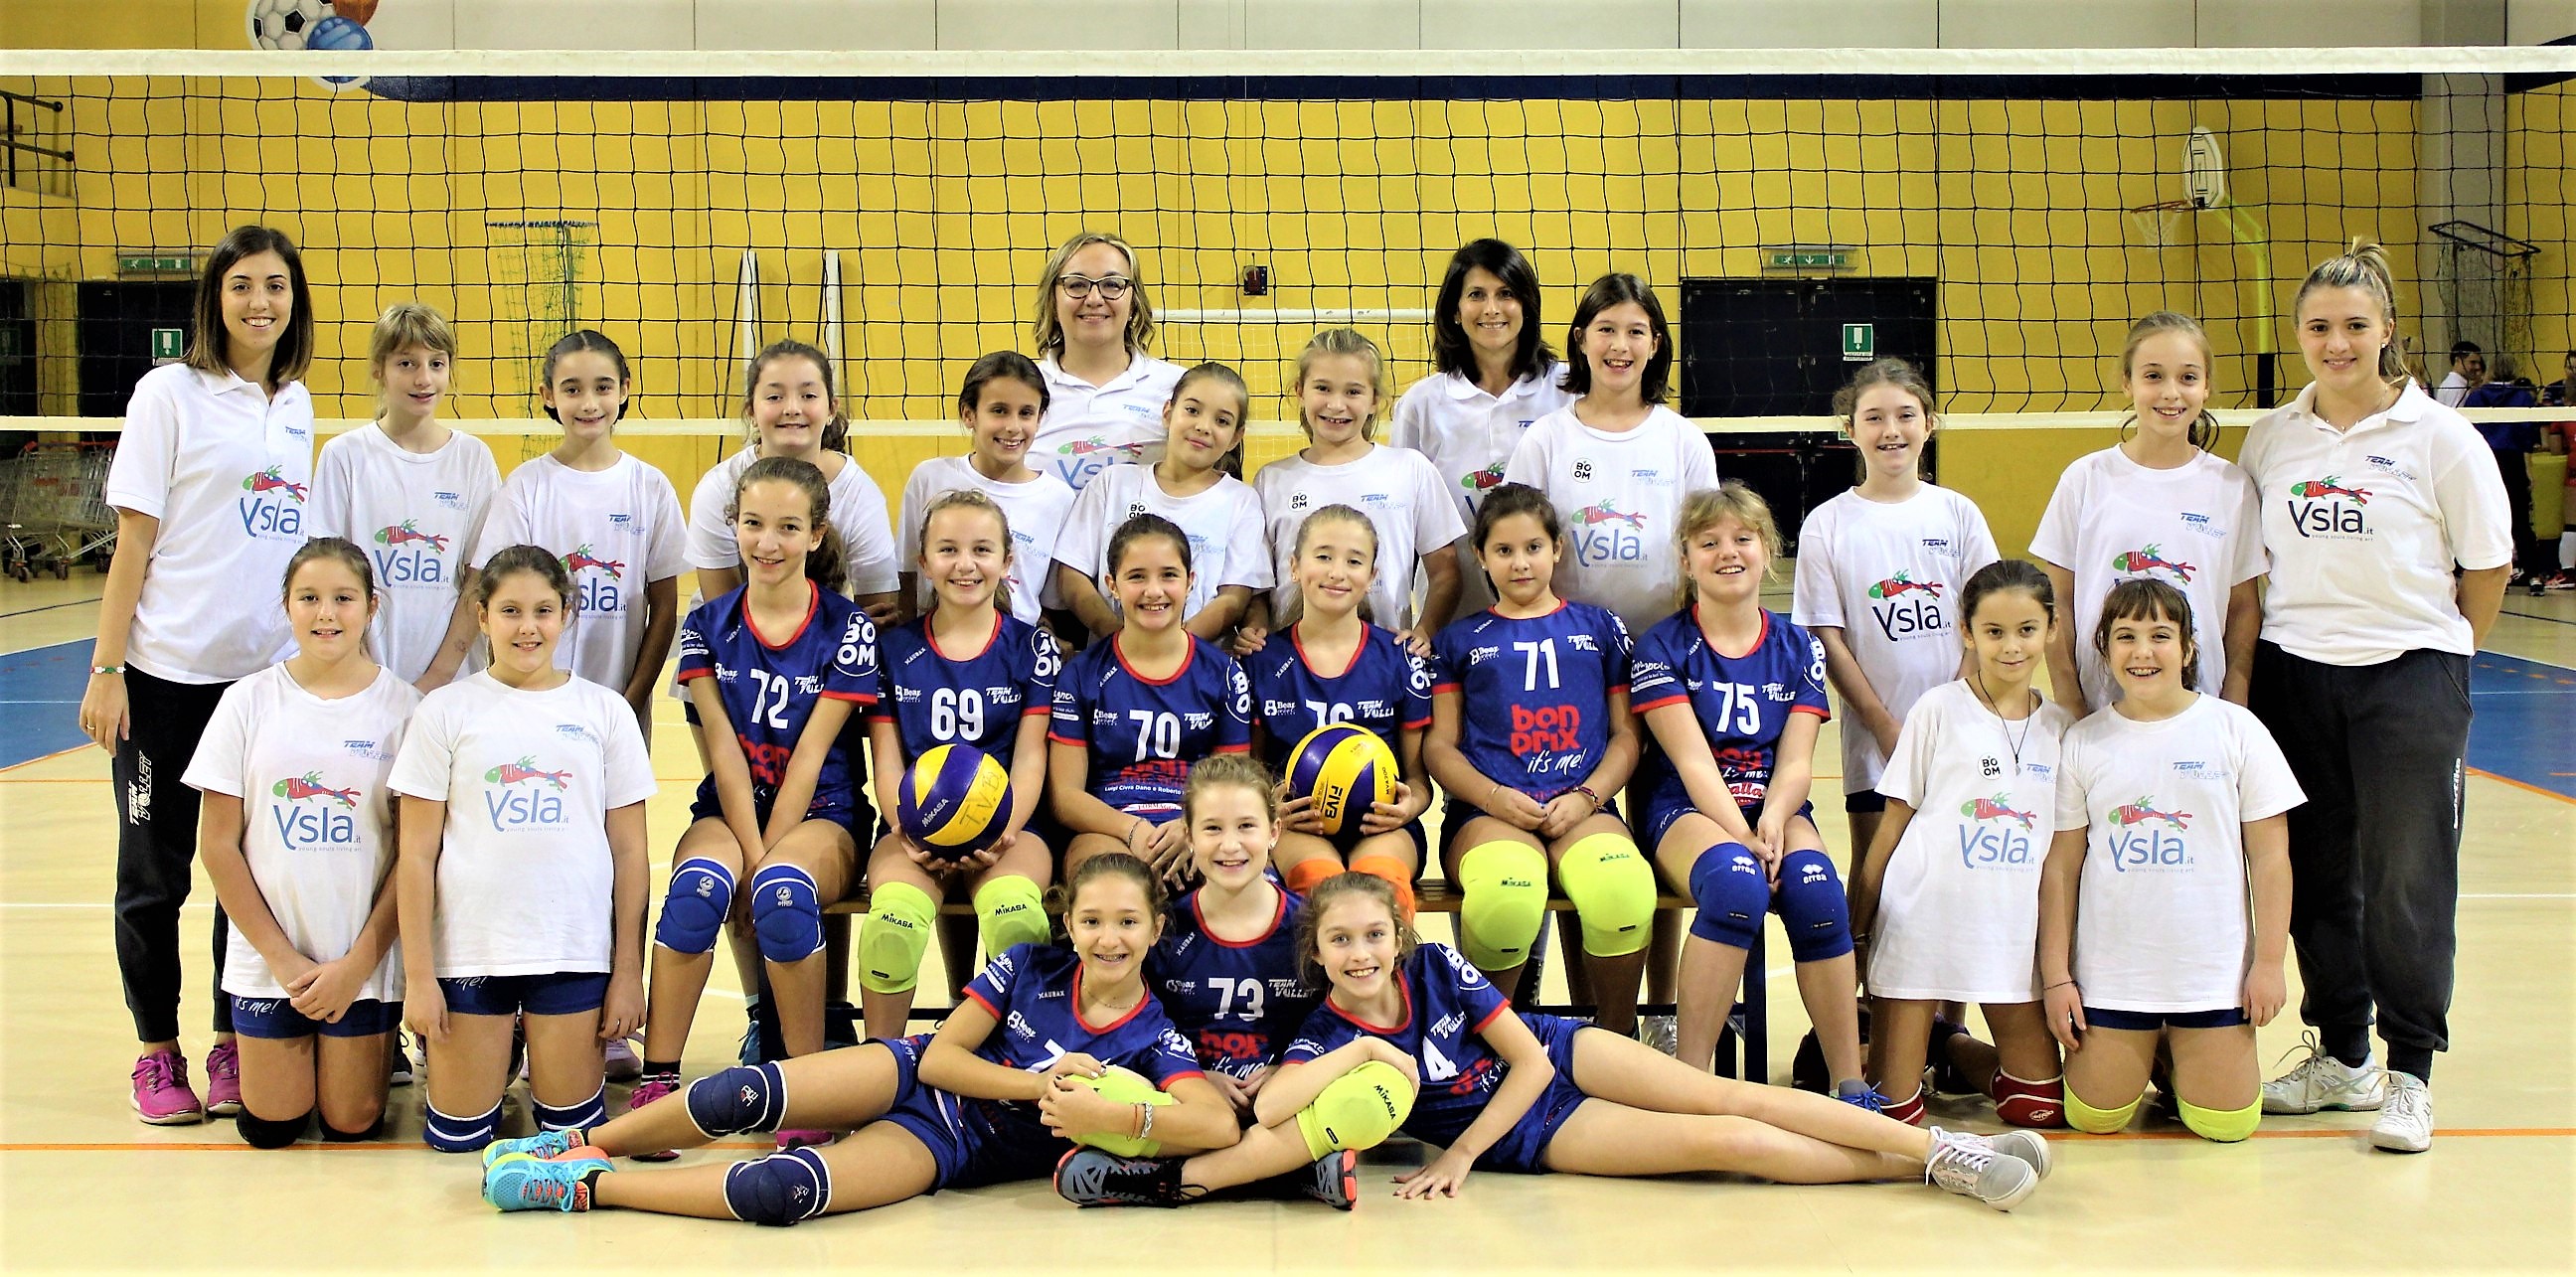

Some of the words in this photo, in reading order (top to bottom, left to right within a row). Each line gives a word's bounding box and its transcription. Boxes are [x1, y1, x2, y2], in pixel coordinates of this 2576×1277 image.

[2365, 455, 2396, 467] TEAM
[434, 492, 460, 501] TEAM
[2180, 512, 2210, 524] TEAM
[837, 644, 876, 667] OM
[1513, 637, 1560, 692] 71
[749, 668, 789, 729] 72
[1357, 700, 1384, 711] TEAM
[1710, 681, 1761, 736] 75
[931, 687, 984, 742] 69
[1512, 704, 1580, 730] bon
[344, 739, 377, 748] TEAM
[1129, 709, 1182, 763] 70
[1511, 728, 1582, 758] prix
[1527, 748, 1553, 774] it's
[1554, 747, 1587, 775] me!
[2026, 763, 2052, 773] TEAM
[2174, 761, 2205, 771] TEAM
[921, 798, 950, 829] MIKASA
[881, 913, 914, 930] MIKASA
[995, 904, 1028, 916] MIKASA
[1268, 979, 1298, 989] TEAM
[248, 999, 282, 1018] me!
[1208, 977, 1264, 1022] 73
[1373, 1084, 1396, 1120] MIKASA
